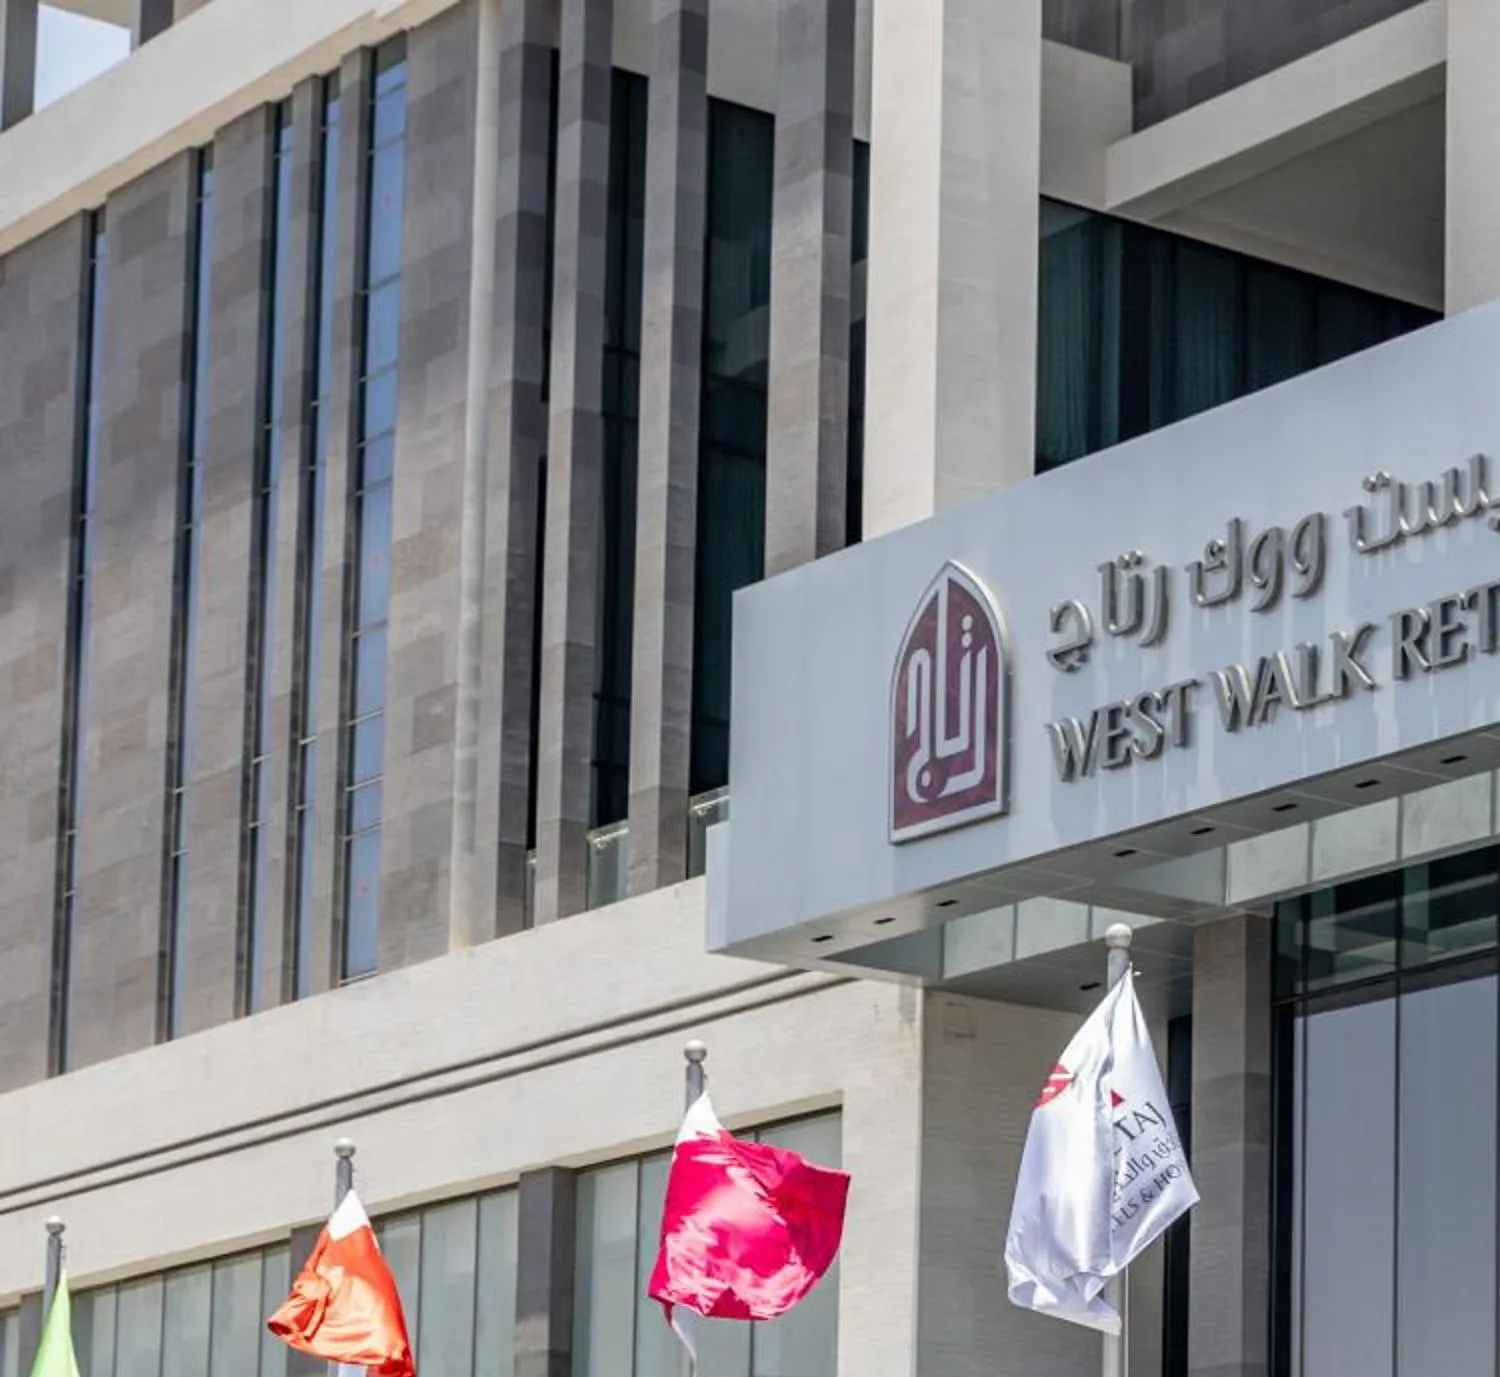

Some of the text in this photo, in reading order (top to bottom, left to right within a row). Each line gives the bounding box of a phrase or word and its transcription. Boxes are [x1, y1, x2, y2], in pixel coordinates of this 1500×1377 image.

[1045, 549, 1170, 673] رتاج
[1184, 512, 1326, 613] ووك
[1044, 677, 1202, 782] WEST
[1209, 622, 1379, 733] WALK
[1112, 1101, 1168, 1141] TAJ
